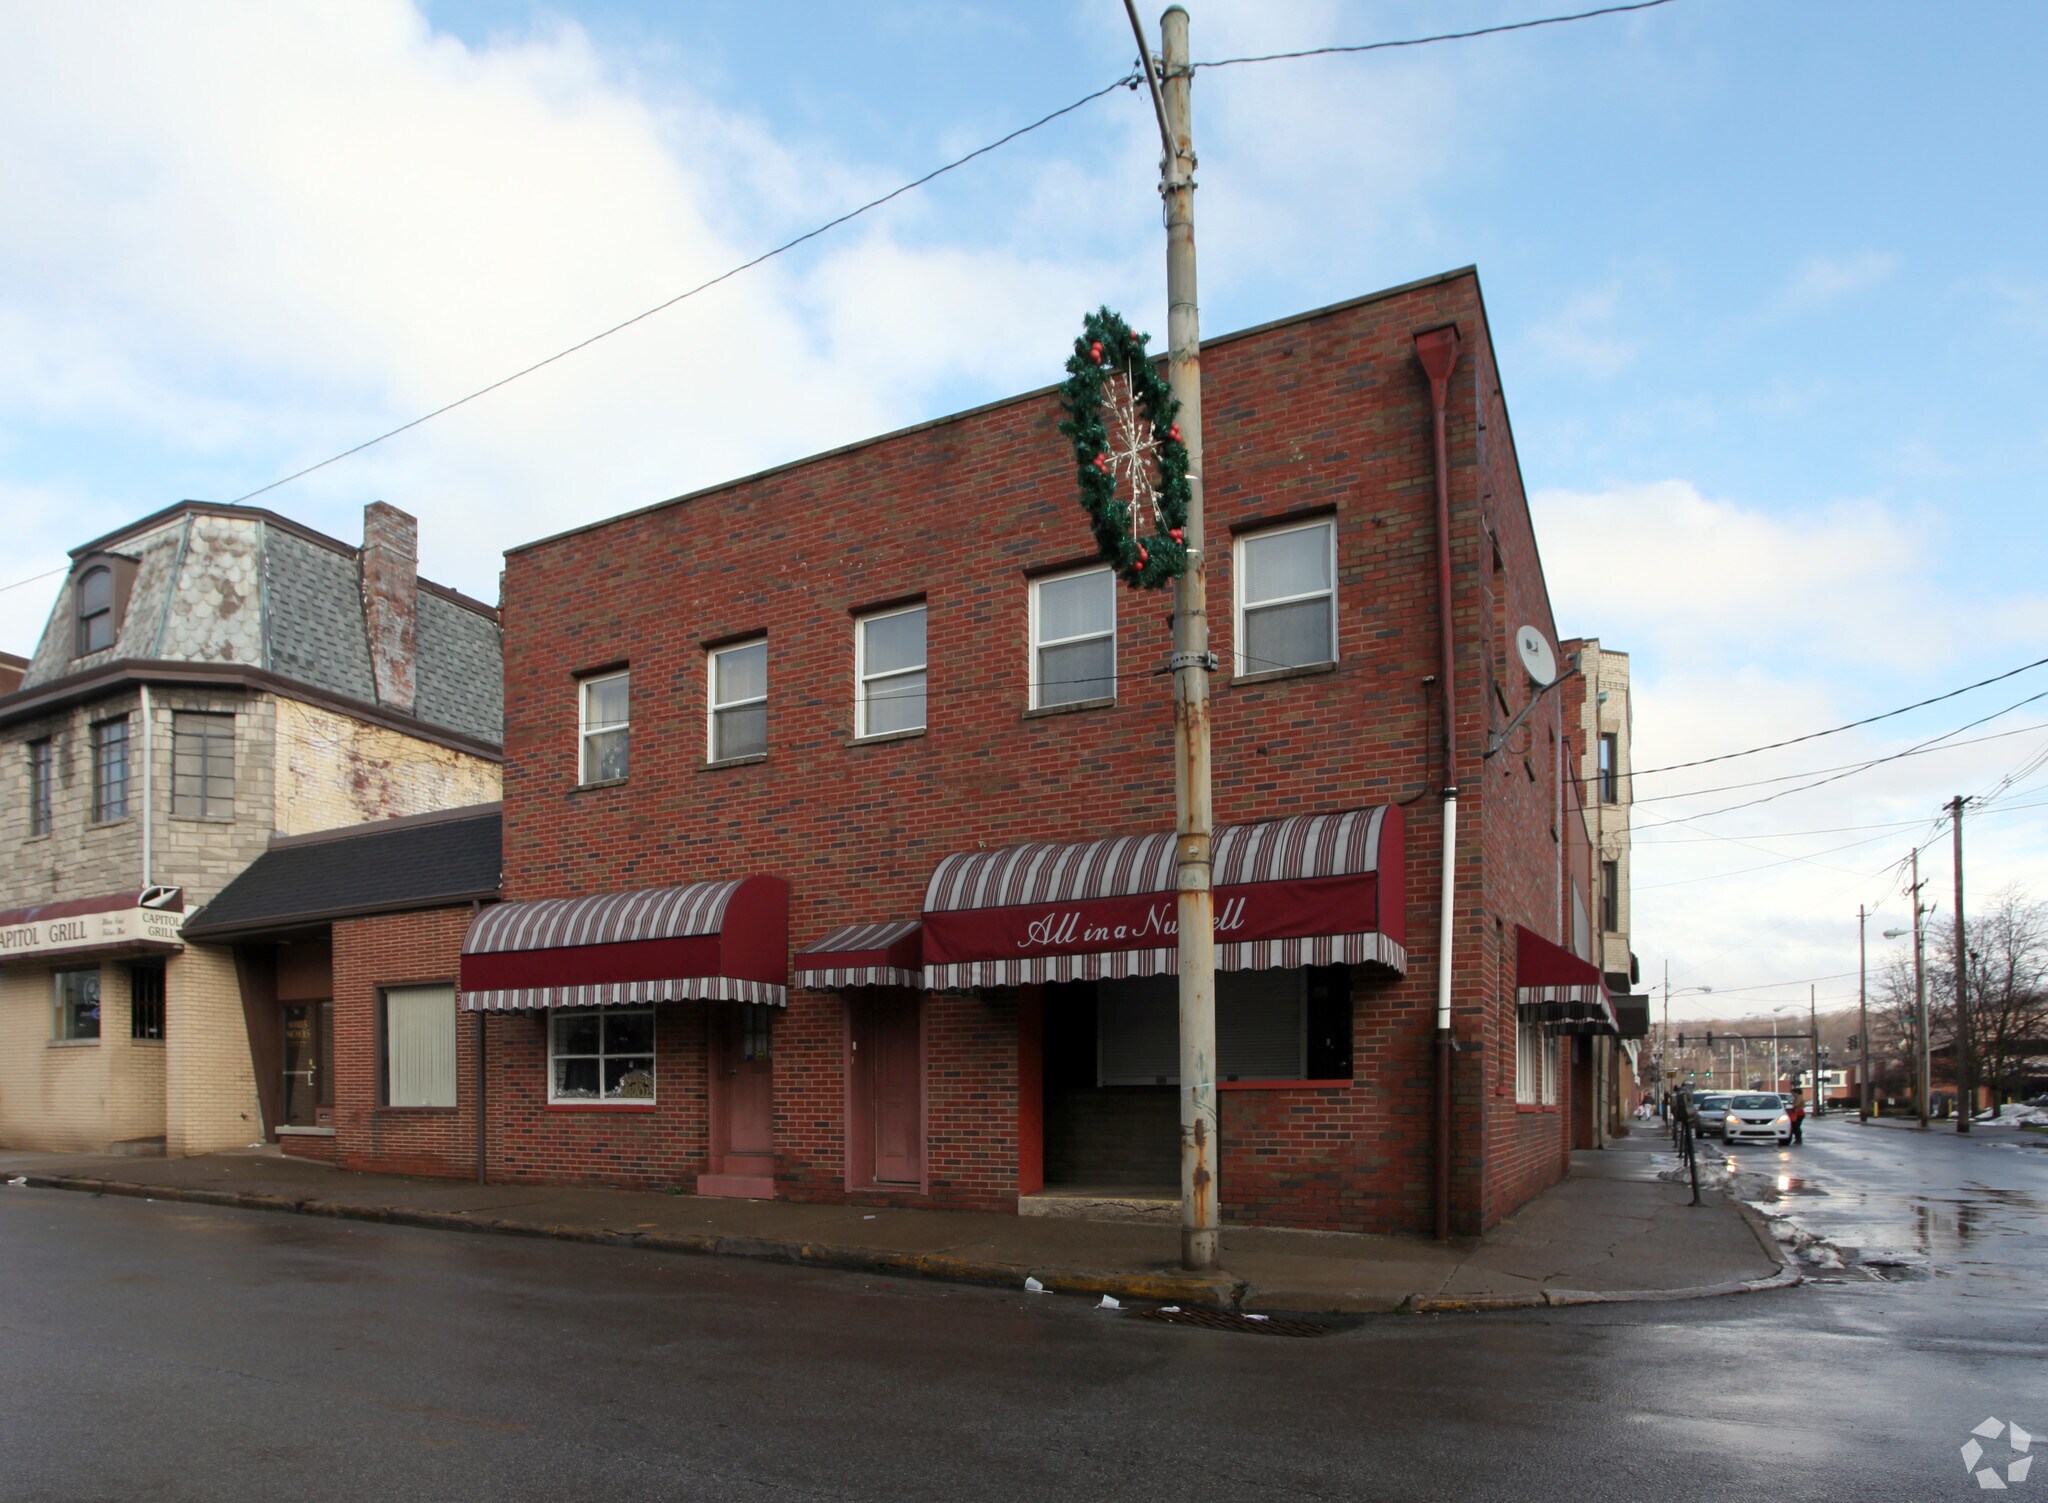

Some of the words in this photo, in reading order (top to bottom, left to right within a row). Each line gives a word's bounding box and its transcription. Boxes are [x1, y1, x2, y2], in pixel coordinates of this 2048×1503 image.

[142, 912, 180, 927] CAPITOL
[1017, 911, 1081, 948] All
[1083, 922, 1110, 942] in
[1113, 923, 1128, 940] a
[1131, 896, 1246, 937] Nuell
[49, 920, 88, 943] GRILL
[148, 925, 175, 939] GRILL
